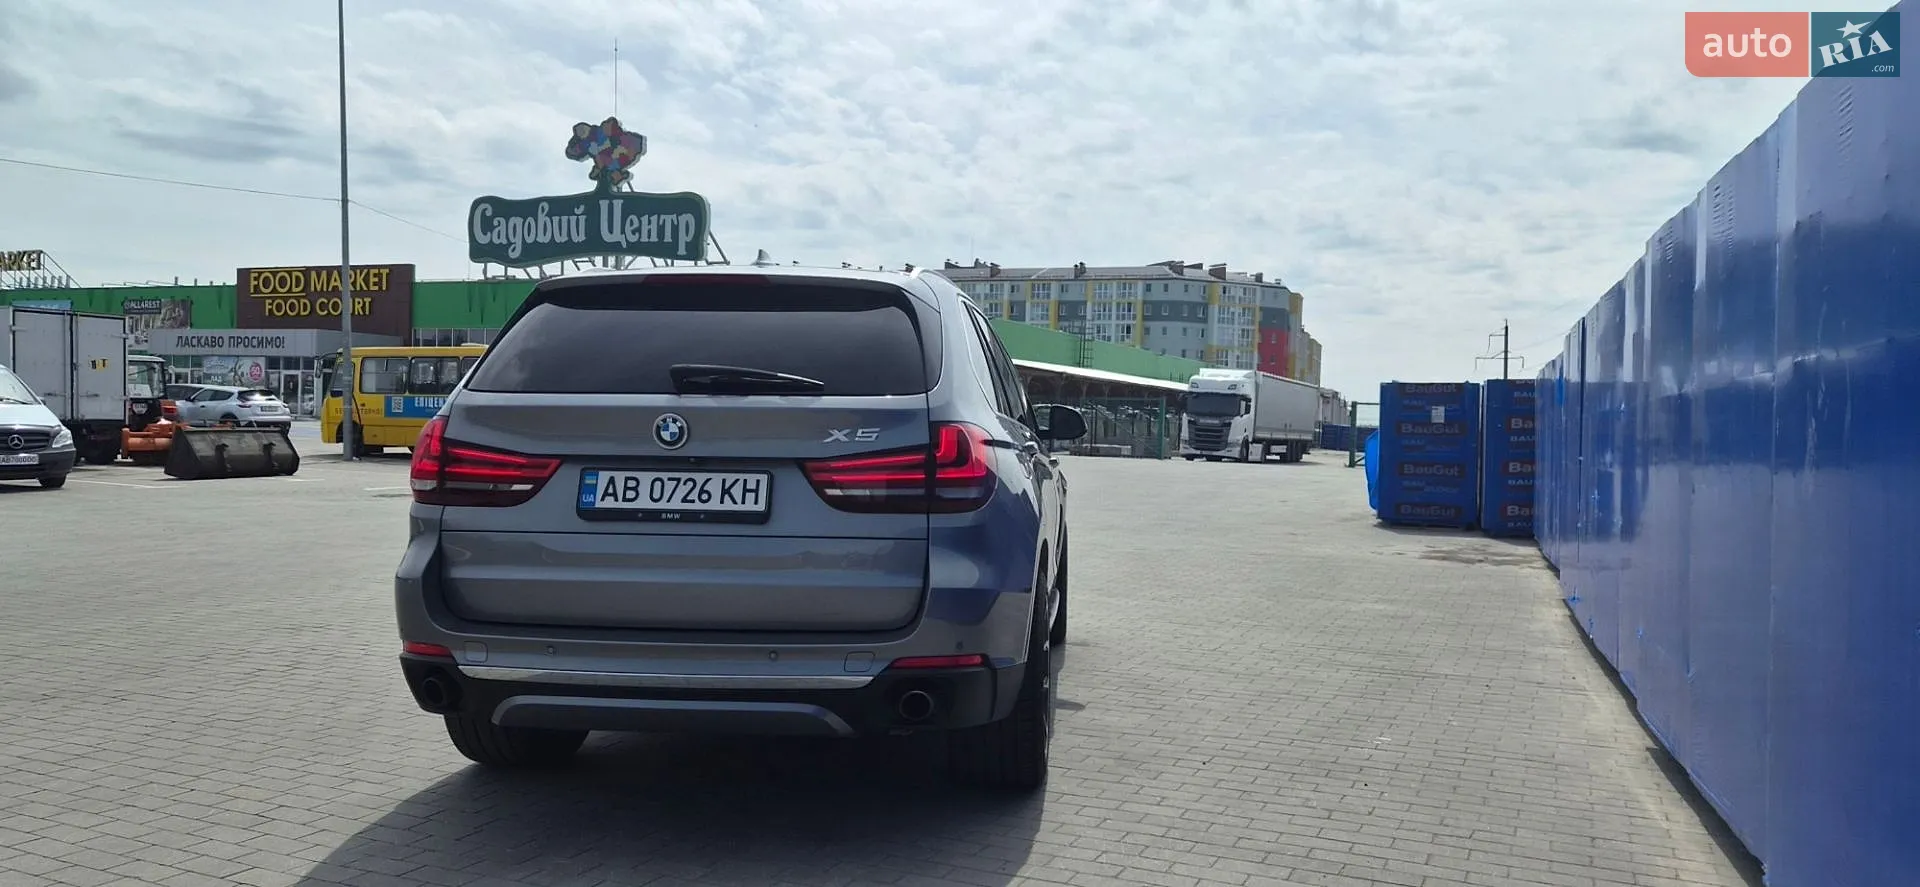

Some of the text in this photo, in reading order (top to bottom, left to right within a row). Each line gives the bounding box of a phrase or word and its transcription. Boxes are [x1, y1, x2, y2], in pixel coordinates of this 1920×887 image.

[473, 199, 695, 258] Садовий Центр
[250, 271, 304, 293] FOOD
[265, 299, 310, 316] FOOD
[176, 336, 285, 349] ЛАСКАВО ПРОСИМО!
[823, 428, 880, 443] X5
[1403, 464, 1460, 476] BauGut
[582, 493, 594, 502] UA
[600, 476, 760, 505] AB 0726 KH
